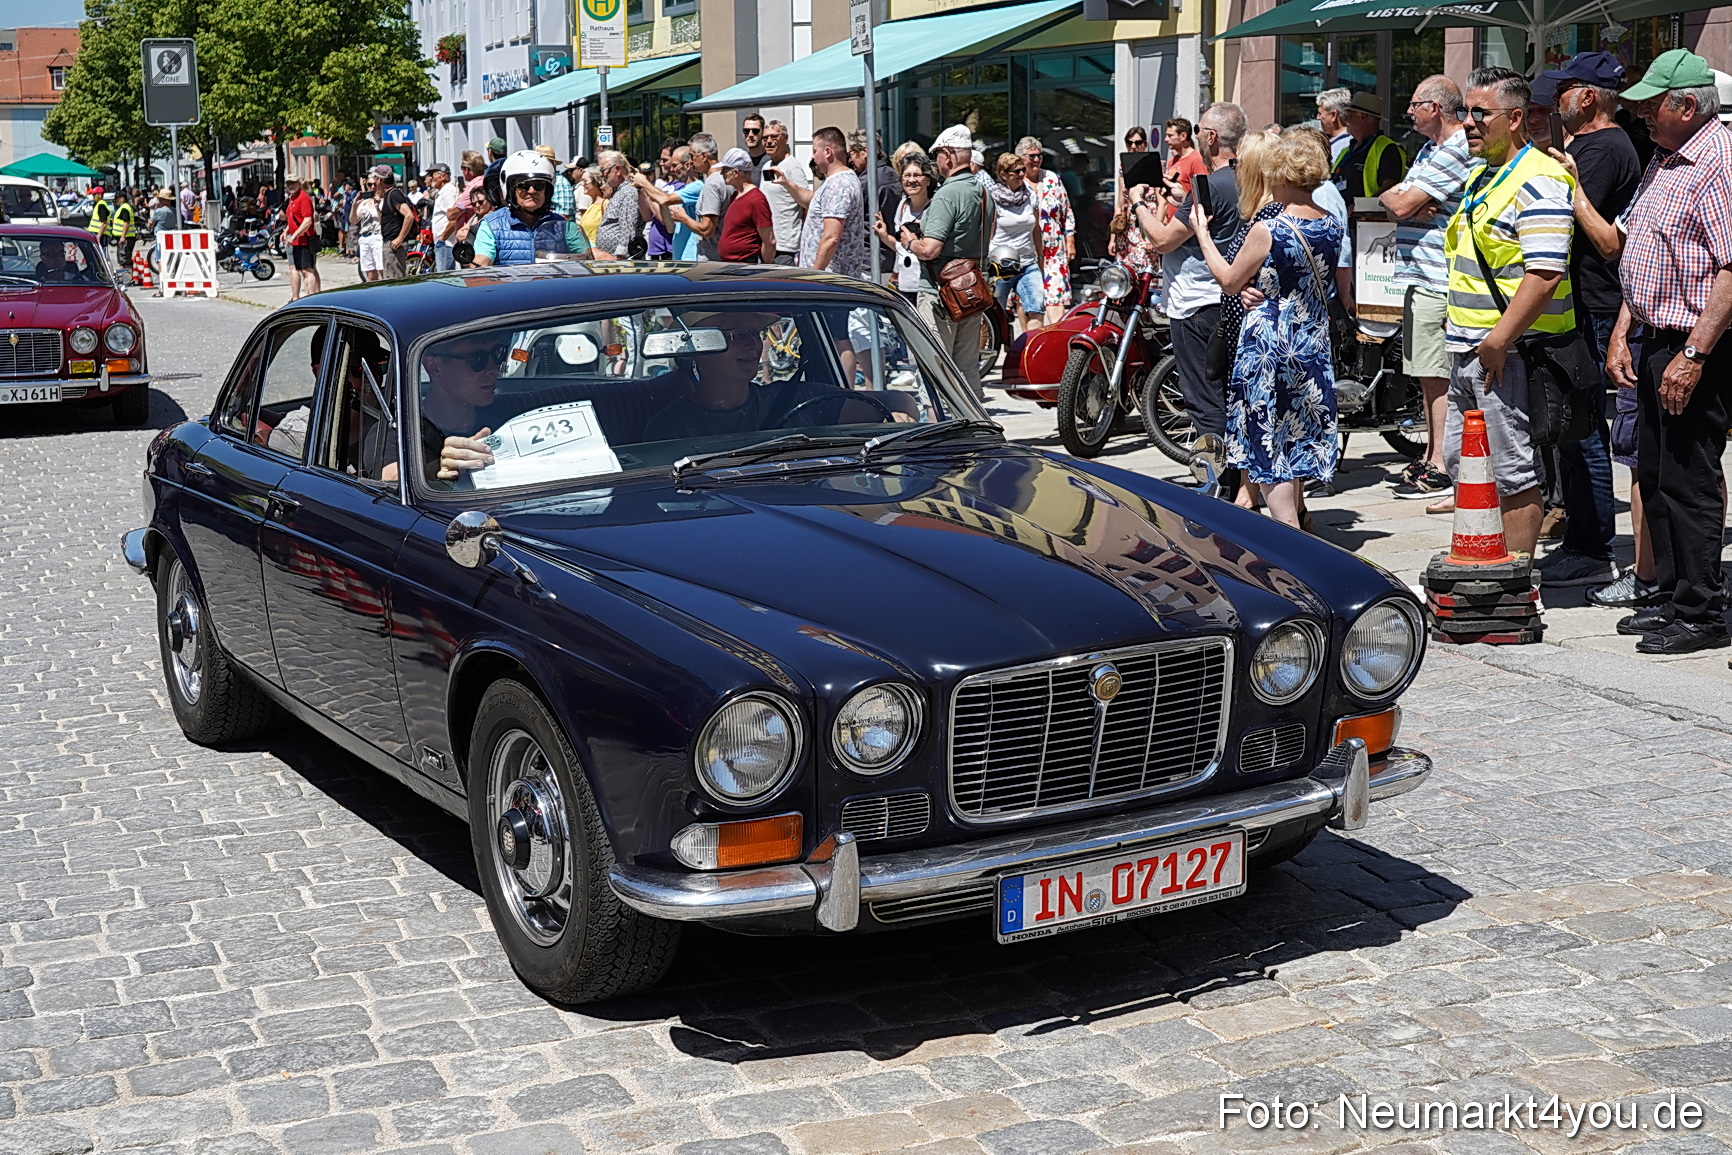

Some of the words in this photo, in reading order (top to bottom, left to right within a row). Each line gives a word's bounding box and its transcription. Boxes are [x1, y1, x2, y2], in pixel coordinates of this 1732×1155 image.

[545, 57, 561, 76] G2
[161, 75, 181, 83] ZONE
[1384, 285, 1406, 296] Neuma
[528, 419, 574, 445] 243
[1035, 871, 1083, 922] IN
[1112, 841, 1232, 905] 07127
[1007, 910, 1016, 923] D
[1012, 929, 1053, 941] HONDA
[1057, 921, 1091, 932] Autohaus
[1092, 915, 1121, 926] SIGL
